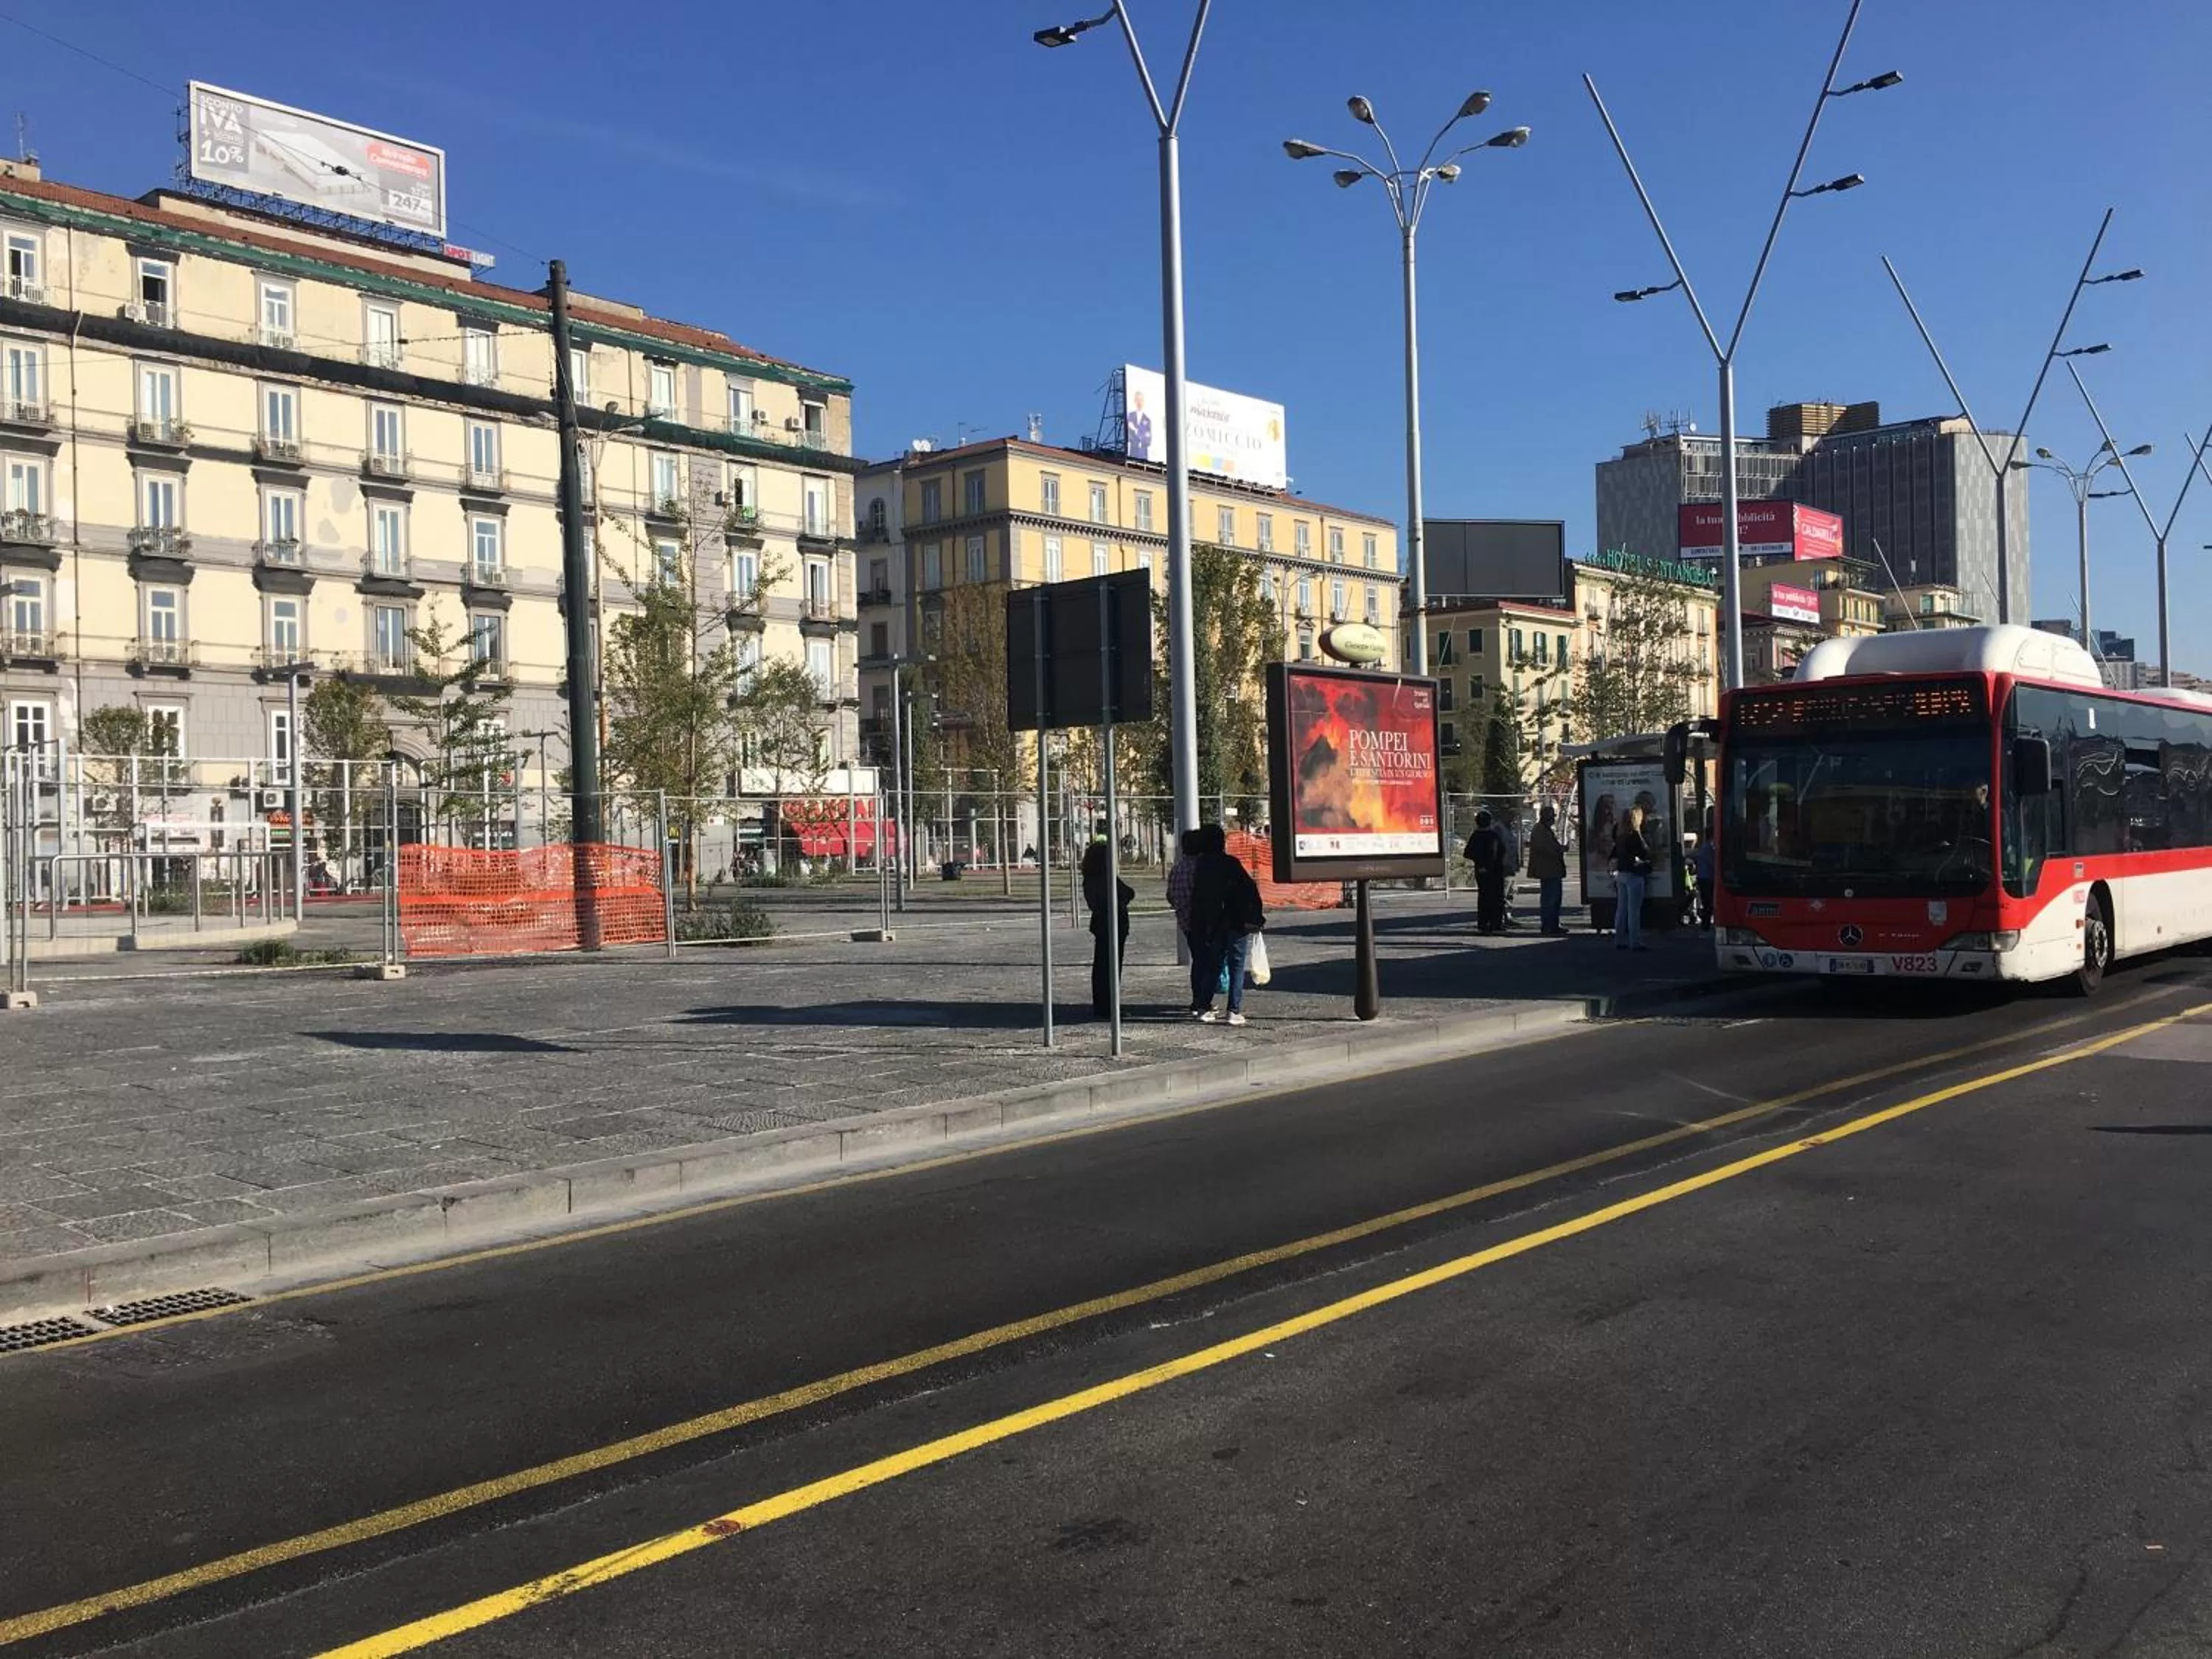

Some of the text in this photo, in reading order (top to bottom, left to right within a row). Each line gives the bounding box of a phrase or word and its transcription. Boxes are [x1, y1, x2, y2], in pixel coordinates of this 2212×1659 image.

[200, 139, 244, 164] 10%
[1607, 549, 1643, 574] HOTEL
[1349, 728, 1408, 751] POMPEI
[1350, 750, 1431, 769] E SANTORINI
[1891, 956, 1938, 972] V823
